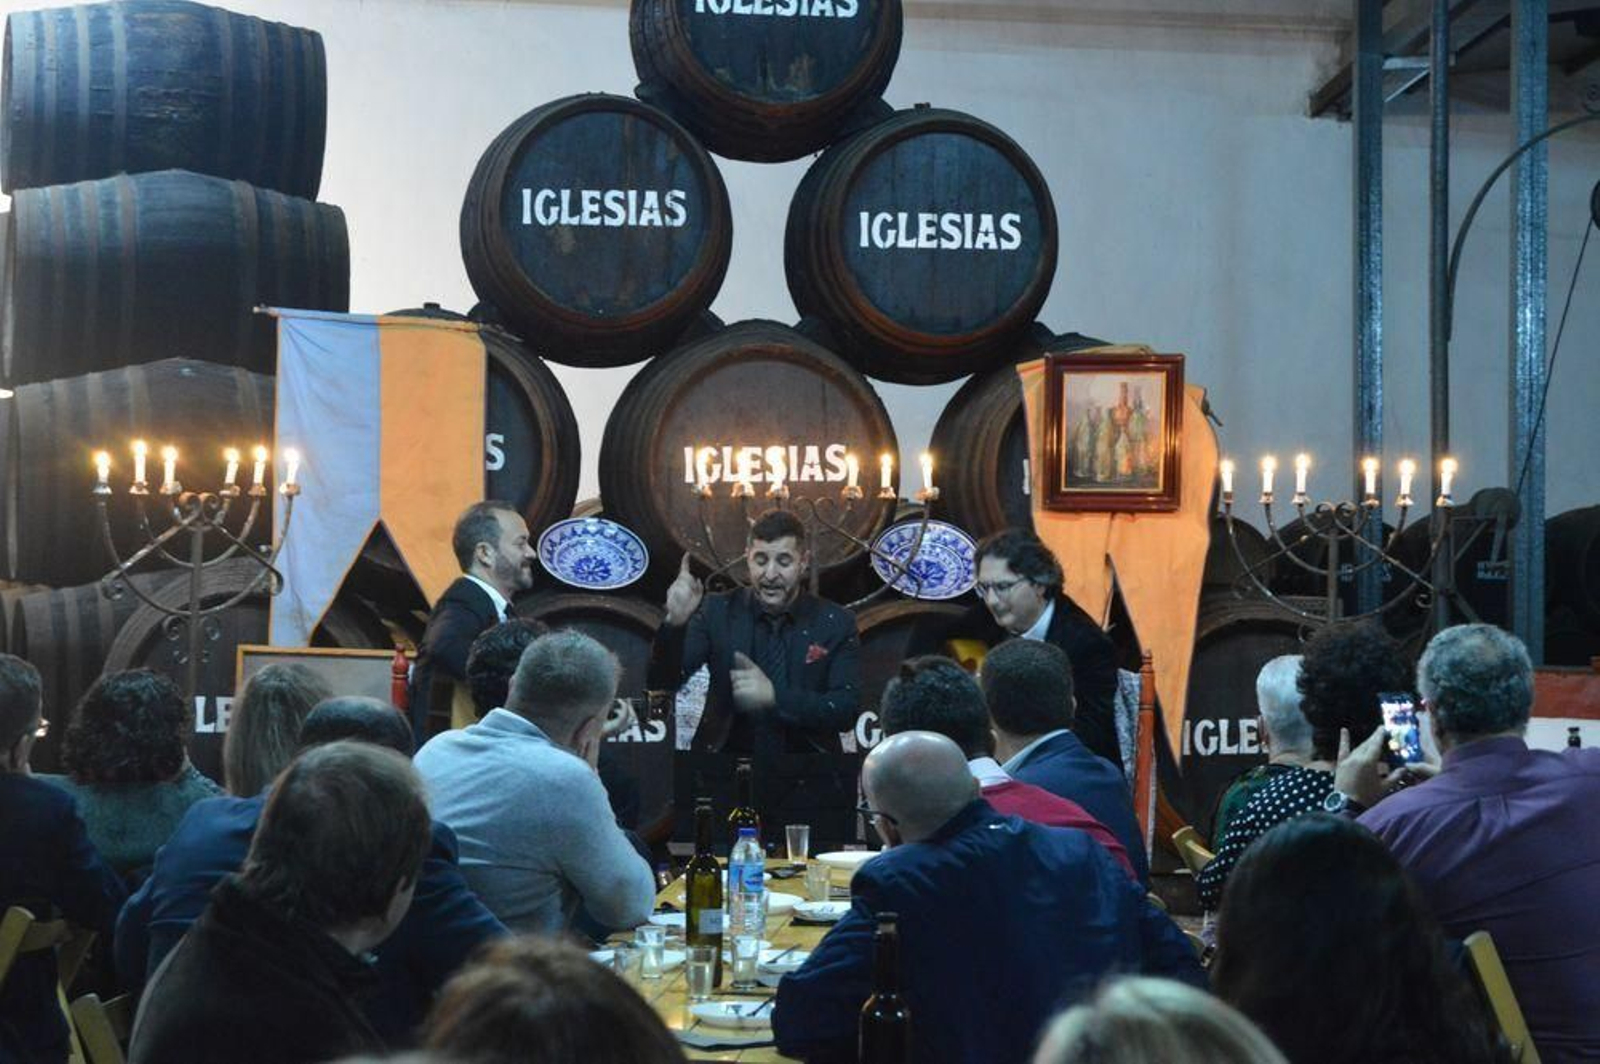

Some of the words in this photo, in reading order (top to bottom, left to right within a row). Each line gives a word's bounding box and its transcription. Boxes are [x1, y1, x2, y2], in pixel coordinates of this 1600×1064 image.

[522, 188, 687, 227] IGLESIAS
[859, 211, 1022, 250] IGLESIAS
[684, 443, 847, 484] IGLESIAS
